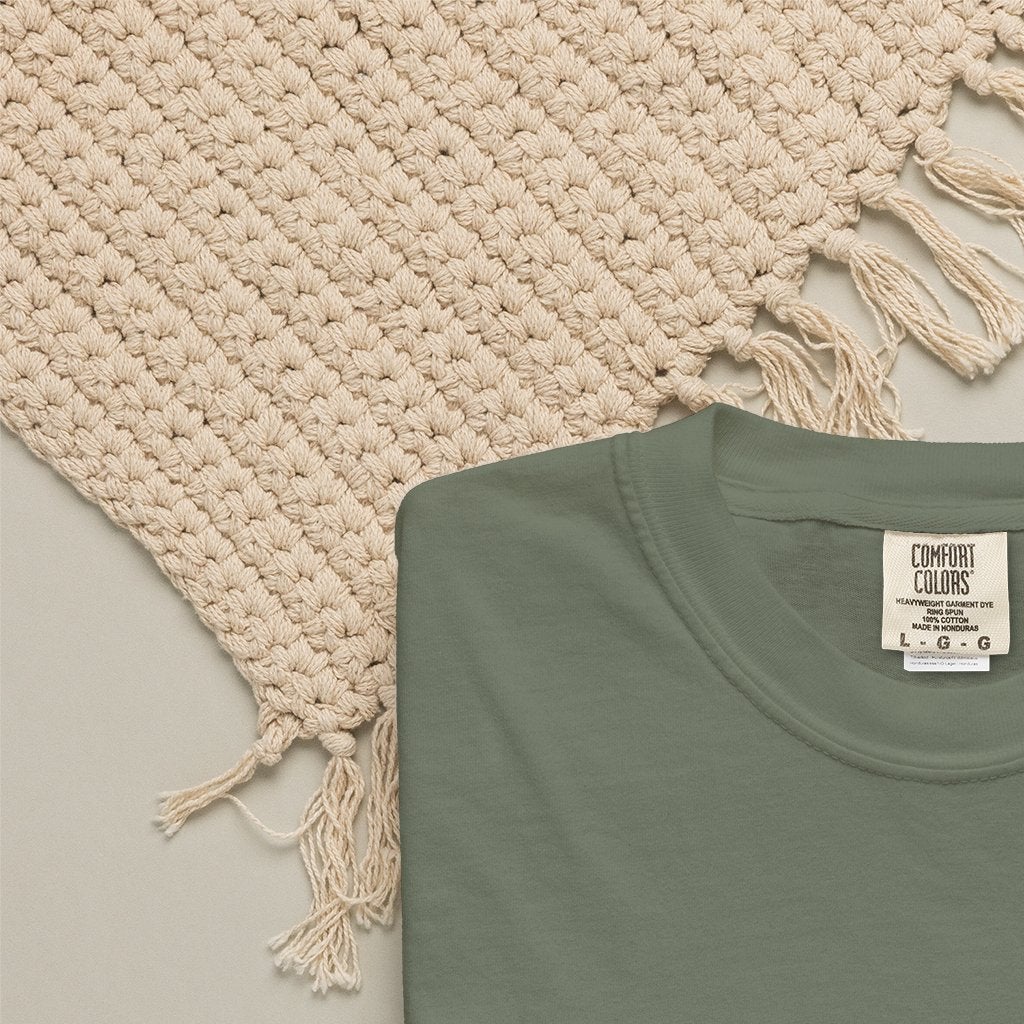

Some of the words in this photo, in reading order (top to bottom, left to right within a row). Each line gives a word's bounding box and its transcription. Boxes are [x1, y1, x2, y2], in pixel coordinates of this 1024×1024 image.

[911, 543, 975, 568] COMFORT
[895, 598, 944, 608] HEAVYWEIGHT
[945, 600, 979, 608] GARMENT
[980, 601, 994, 609] DYE
[922, 616, 940, 624] 100%
[941, 616, 969, 624] COTTON
[911, 623, 932, 632] MADE
[899, 633, 910, 647] L
[936, 635, 950, 650] G
[977, 635, 991, 650] G
